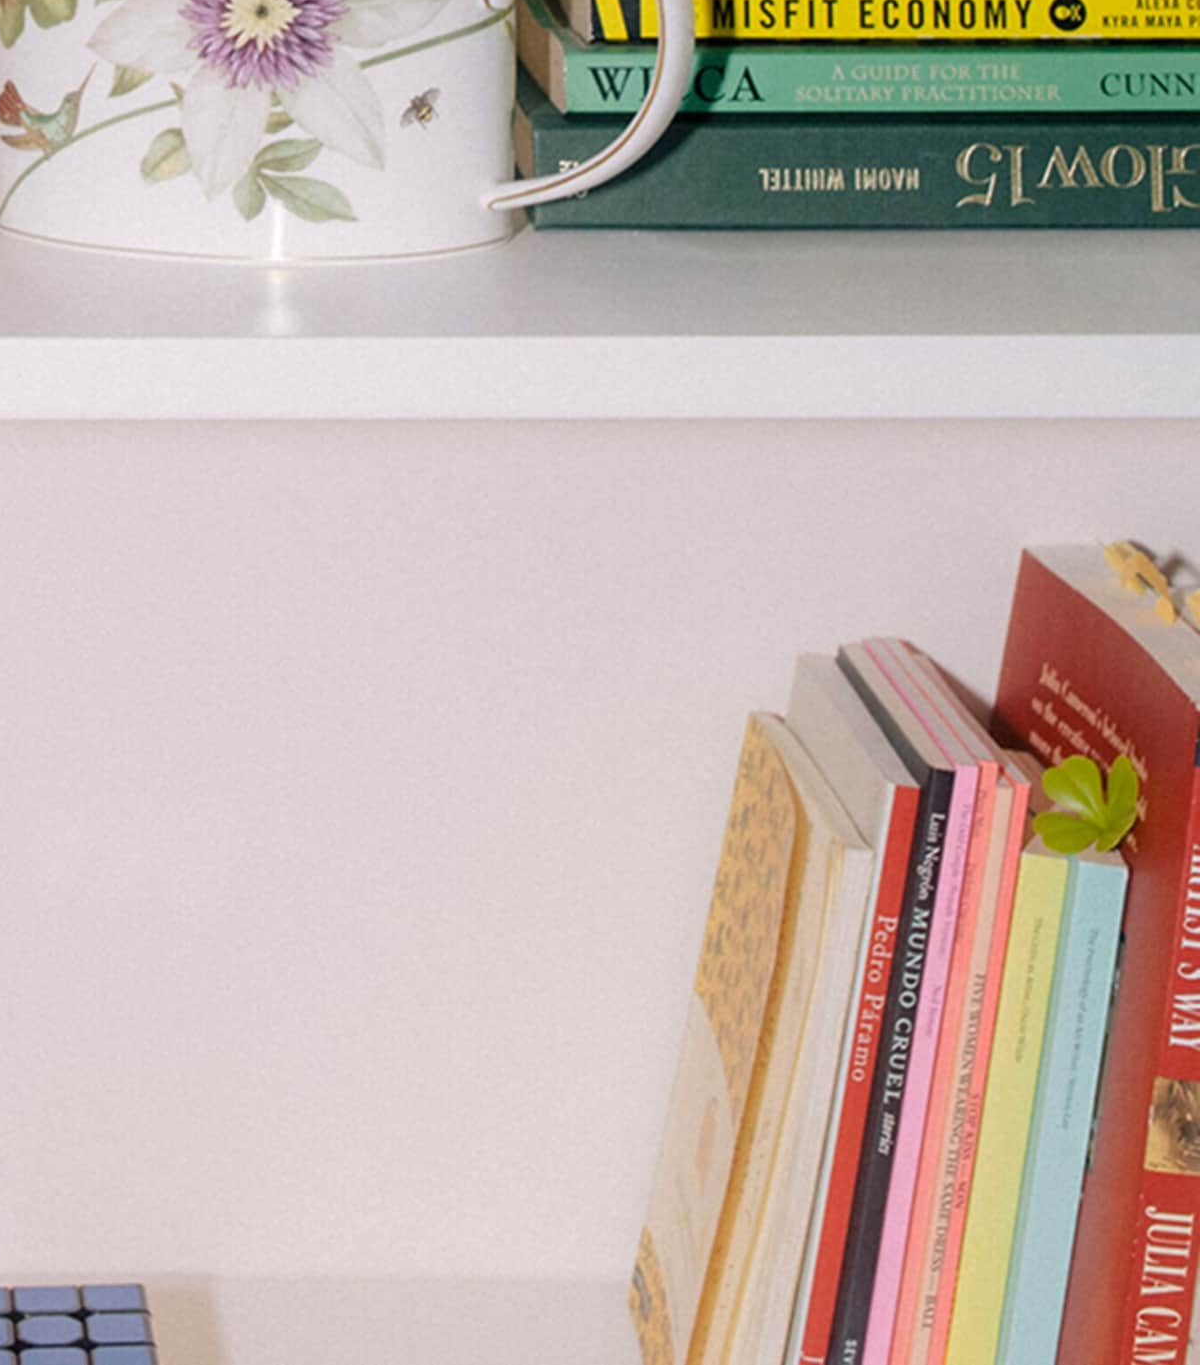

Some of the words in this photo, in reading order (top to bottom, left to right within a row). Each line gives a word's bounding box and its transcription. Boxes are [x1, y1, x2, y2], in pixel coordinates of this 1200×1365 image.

[1102, 15, 1139, 28] KYRA
[1144, 15, 1183, 28] MAYA
[587, 66, 765, 102] WICA
[794, 85, 895, 103] SOLITARY
[900, 85, 1062, 102] PRACTITIONER
[832, 63, 845, 81] A
[851, 63, 921, 81] GUIDE
[929, 63, 971, 81] FOR
[975, 63, 1022, 80] THE
[758, 167, 845, 192] WHITTEL
[854, 167, 920, 191] NAOMI
[927, 812, 945, 842] Luis
[867, 914, 899, 984] Pedro
[899, 906, 931, 1009] MUNDO
[851, 992, 886, 1083] Páramo
[883, 1015, 913, 1104] CRUEL
[960, 1011, 981, 1070] WOMEN
[950, 1073, 970, 1144] WEARING
[877, 1111, 896, 1157] stories
[1140, 1205, 1195, 1297] JULIA
